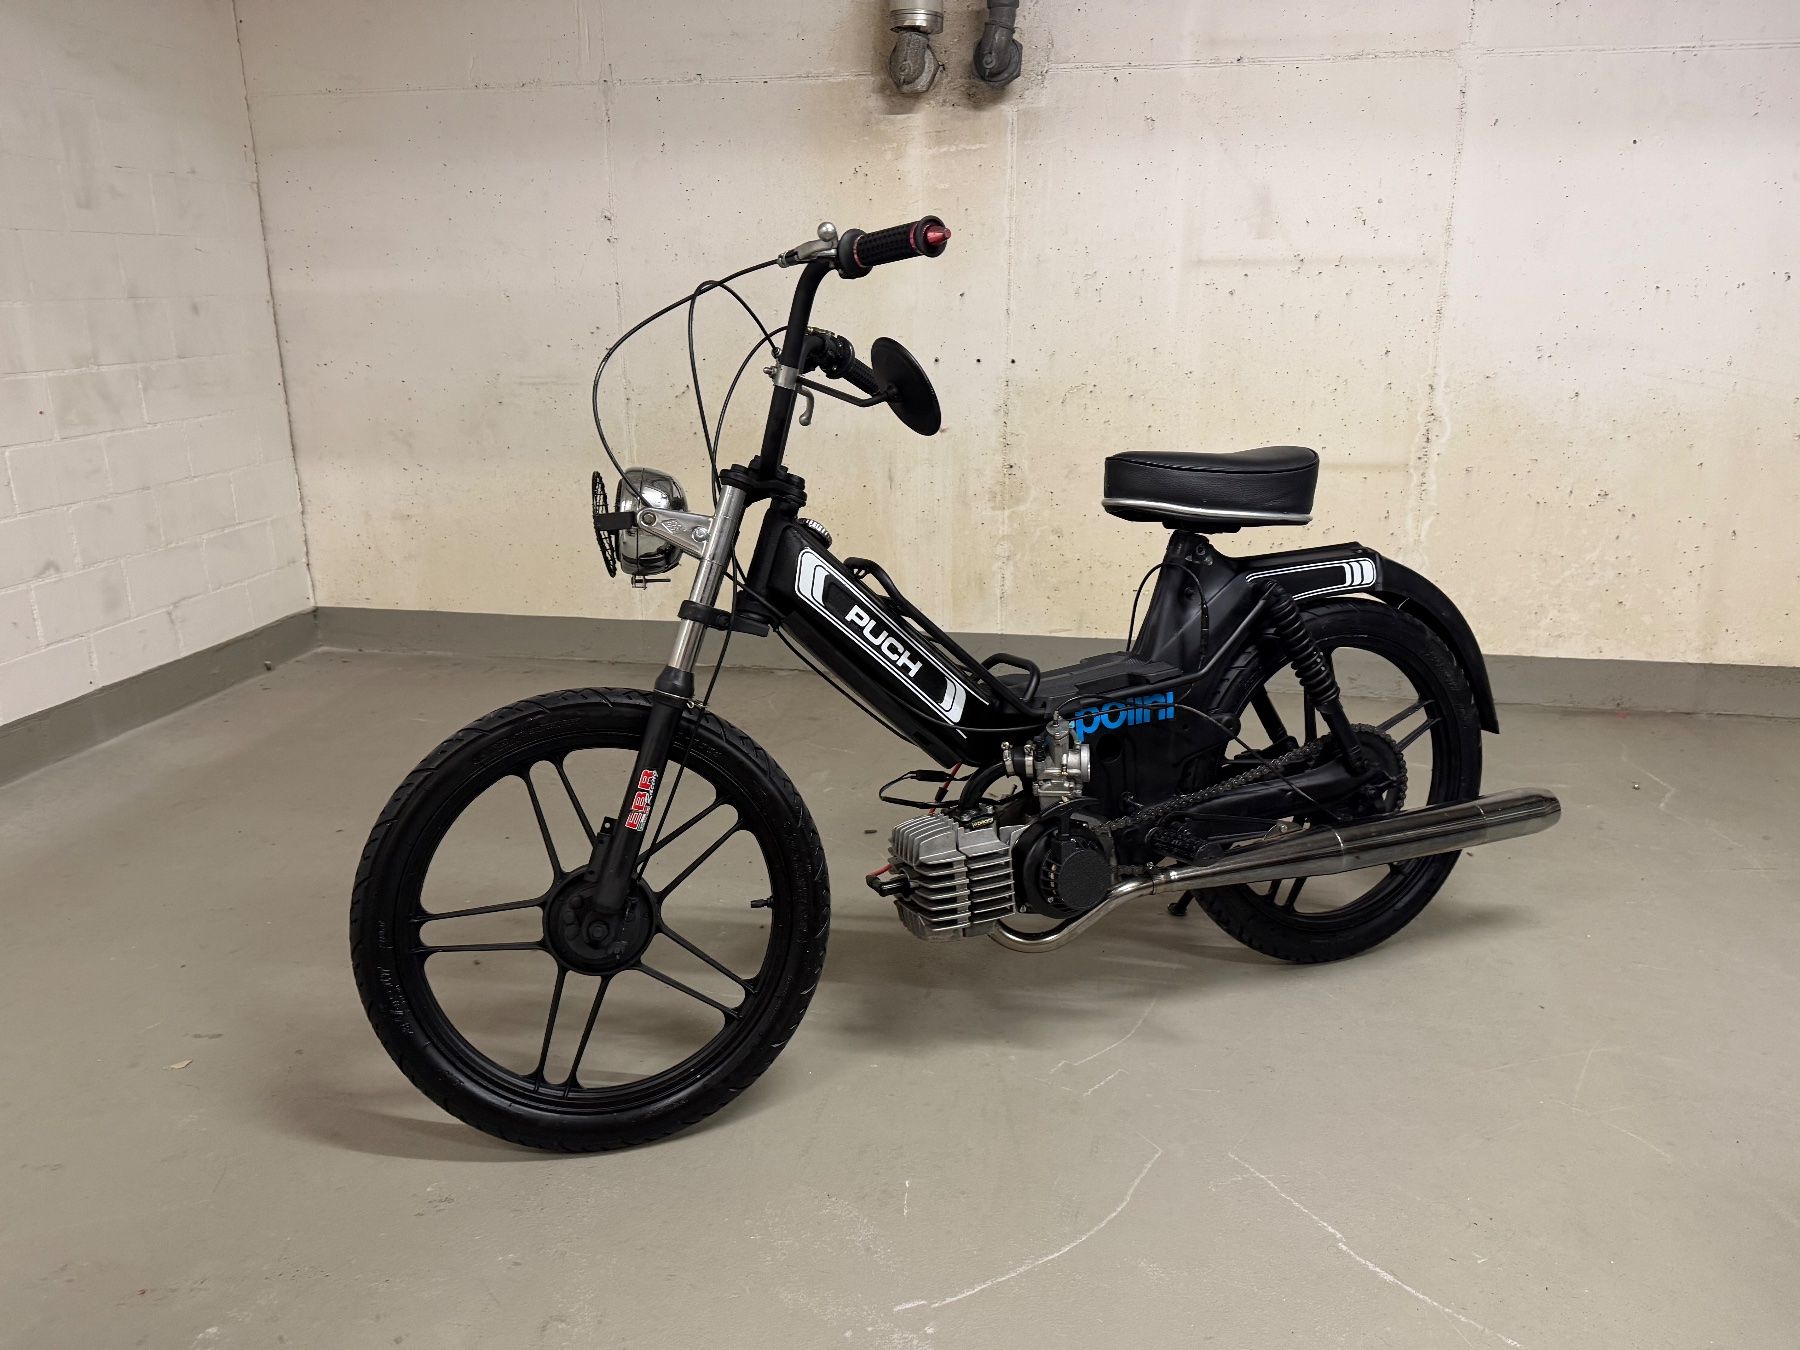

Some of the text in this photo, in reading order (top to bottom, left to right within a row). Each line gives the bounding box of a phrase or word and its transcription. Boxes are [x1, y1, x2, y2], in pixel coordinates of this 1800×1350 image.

[844, 604, 923, 678] PUCH
[1074, 691, 1174, 744] polini
[625, 769, 655, 829] EBR
